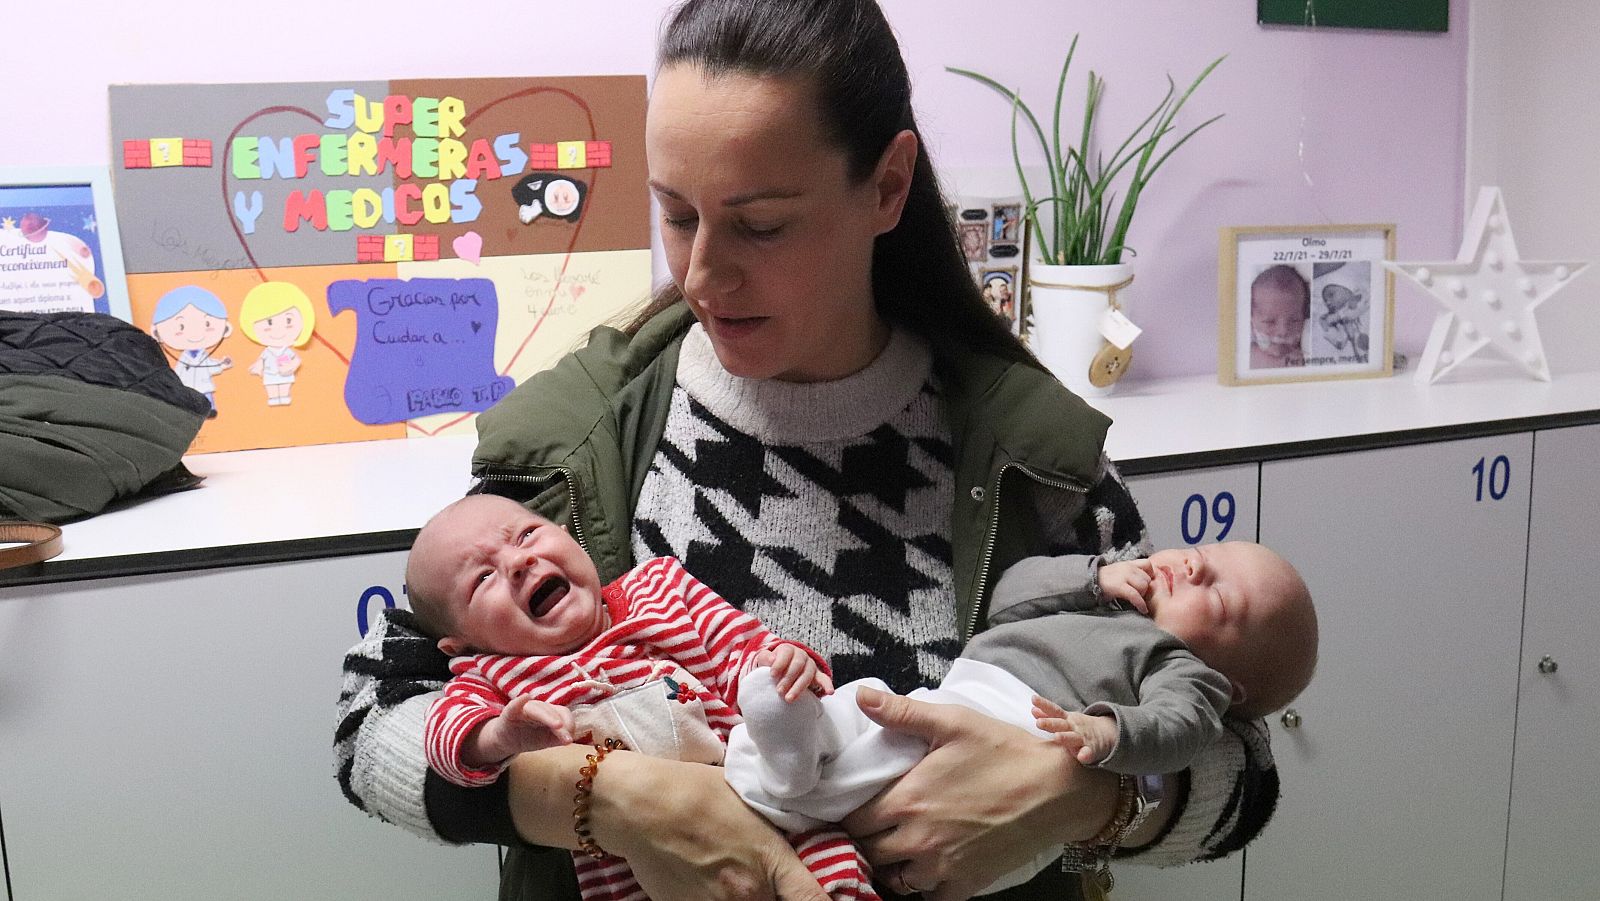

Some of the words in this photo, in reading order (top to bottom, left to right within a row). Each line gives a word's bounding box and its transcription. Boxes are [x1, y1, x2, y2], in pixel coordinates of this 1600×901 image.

[324, 89, 466, 137] SUPER
[232, 131, 528, 180] ENFERMERAS
[234, 190, 263, 234] Y
[283, 178, 483, 232] MEDICOS
[0, 244, 47, 259] Certificat
[1273, 251, 1308, 261] 22/7/21
[1318, 250, 1352, 260] 29/7/21
[1302, 238, 1326, 247] Olmo
[367, 286, 445, 316] Gracias
[449, 292, 481, 311] por
[373, 320, 429, 345] Cuidar
[1471, 454, 1511, 502] 10
[1180, 491, 1236, 545] 09
[357, 585, 408, 640] 0
